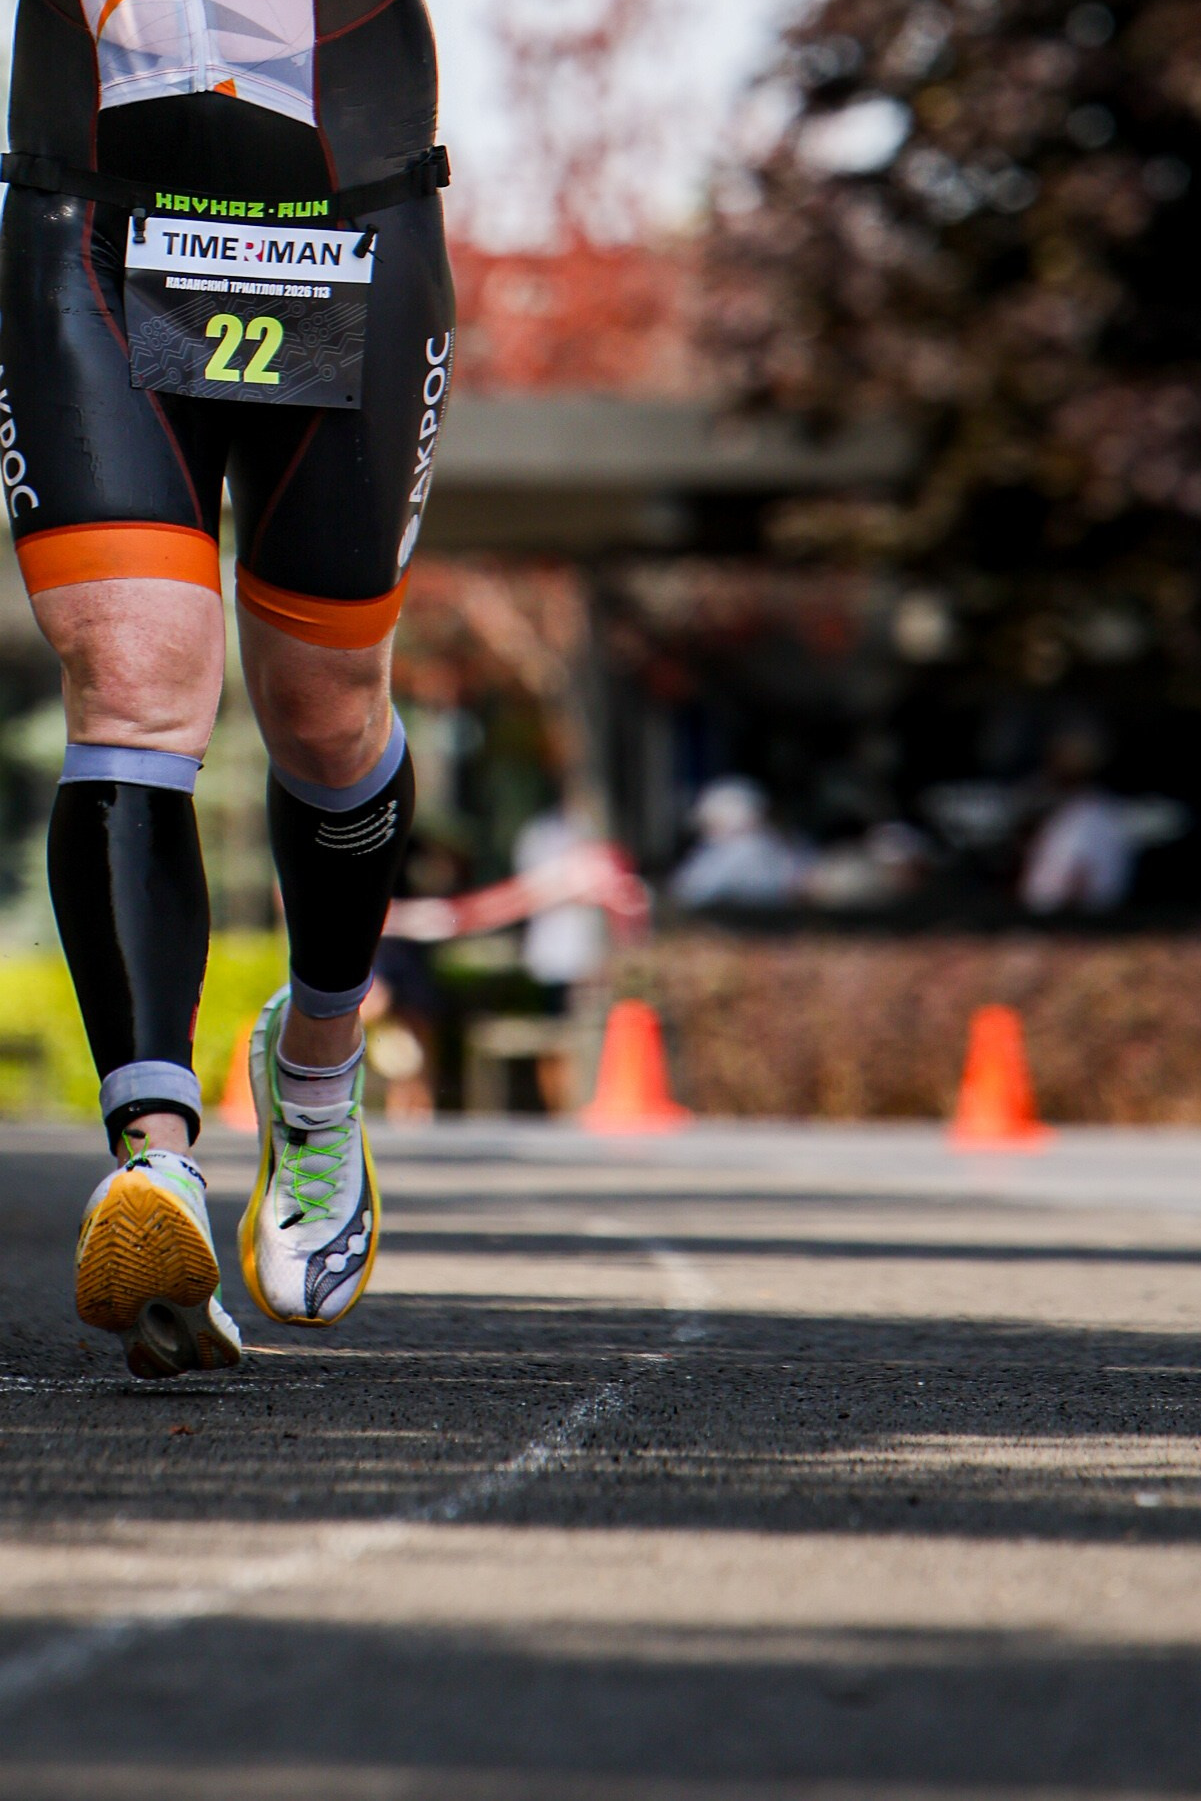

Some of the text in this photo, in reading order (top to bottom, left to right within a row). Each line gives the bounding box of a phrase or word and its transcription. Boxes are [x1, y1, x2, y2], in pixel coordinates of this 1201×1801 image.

[165, 276, 228, 292] КАЗАНСКИЙ
[230, 281, 284, 296] ТРИАТЛОН
[312, 286, 331, 299] 113
[205, 313, 283, 384] 22
[409, 332, 450, 503] АКРОС
